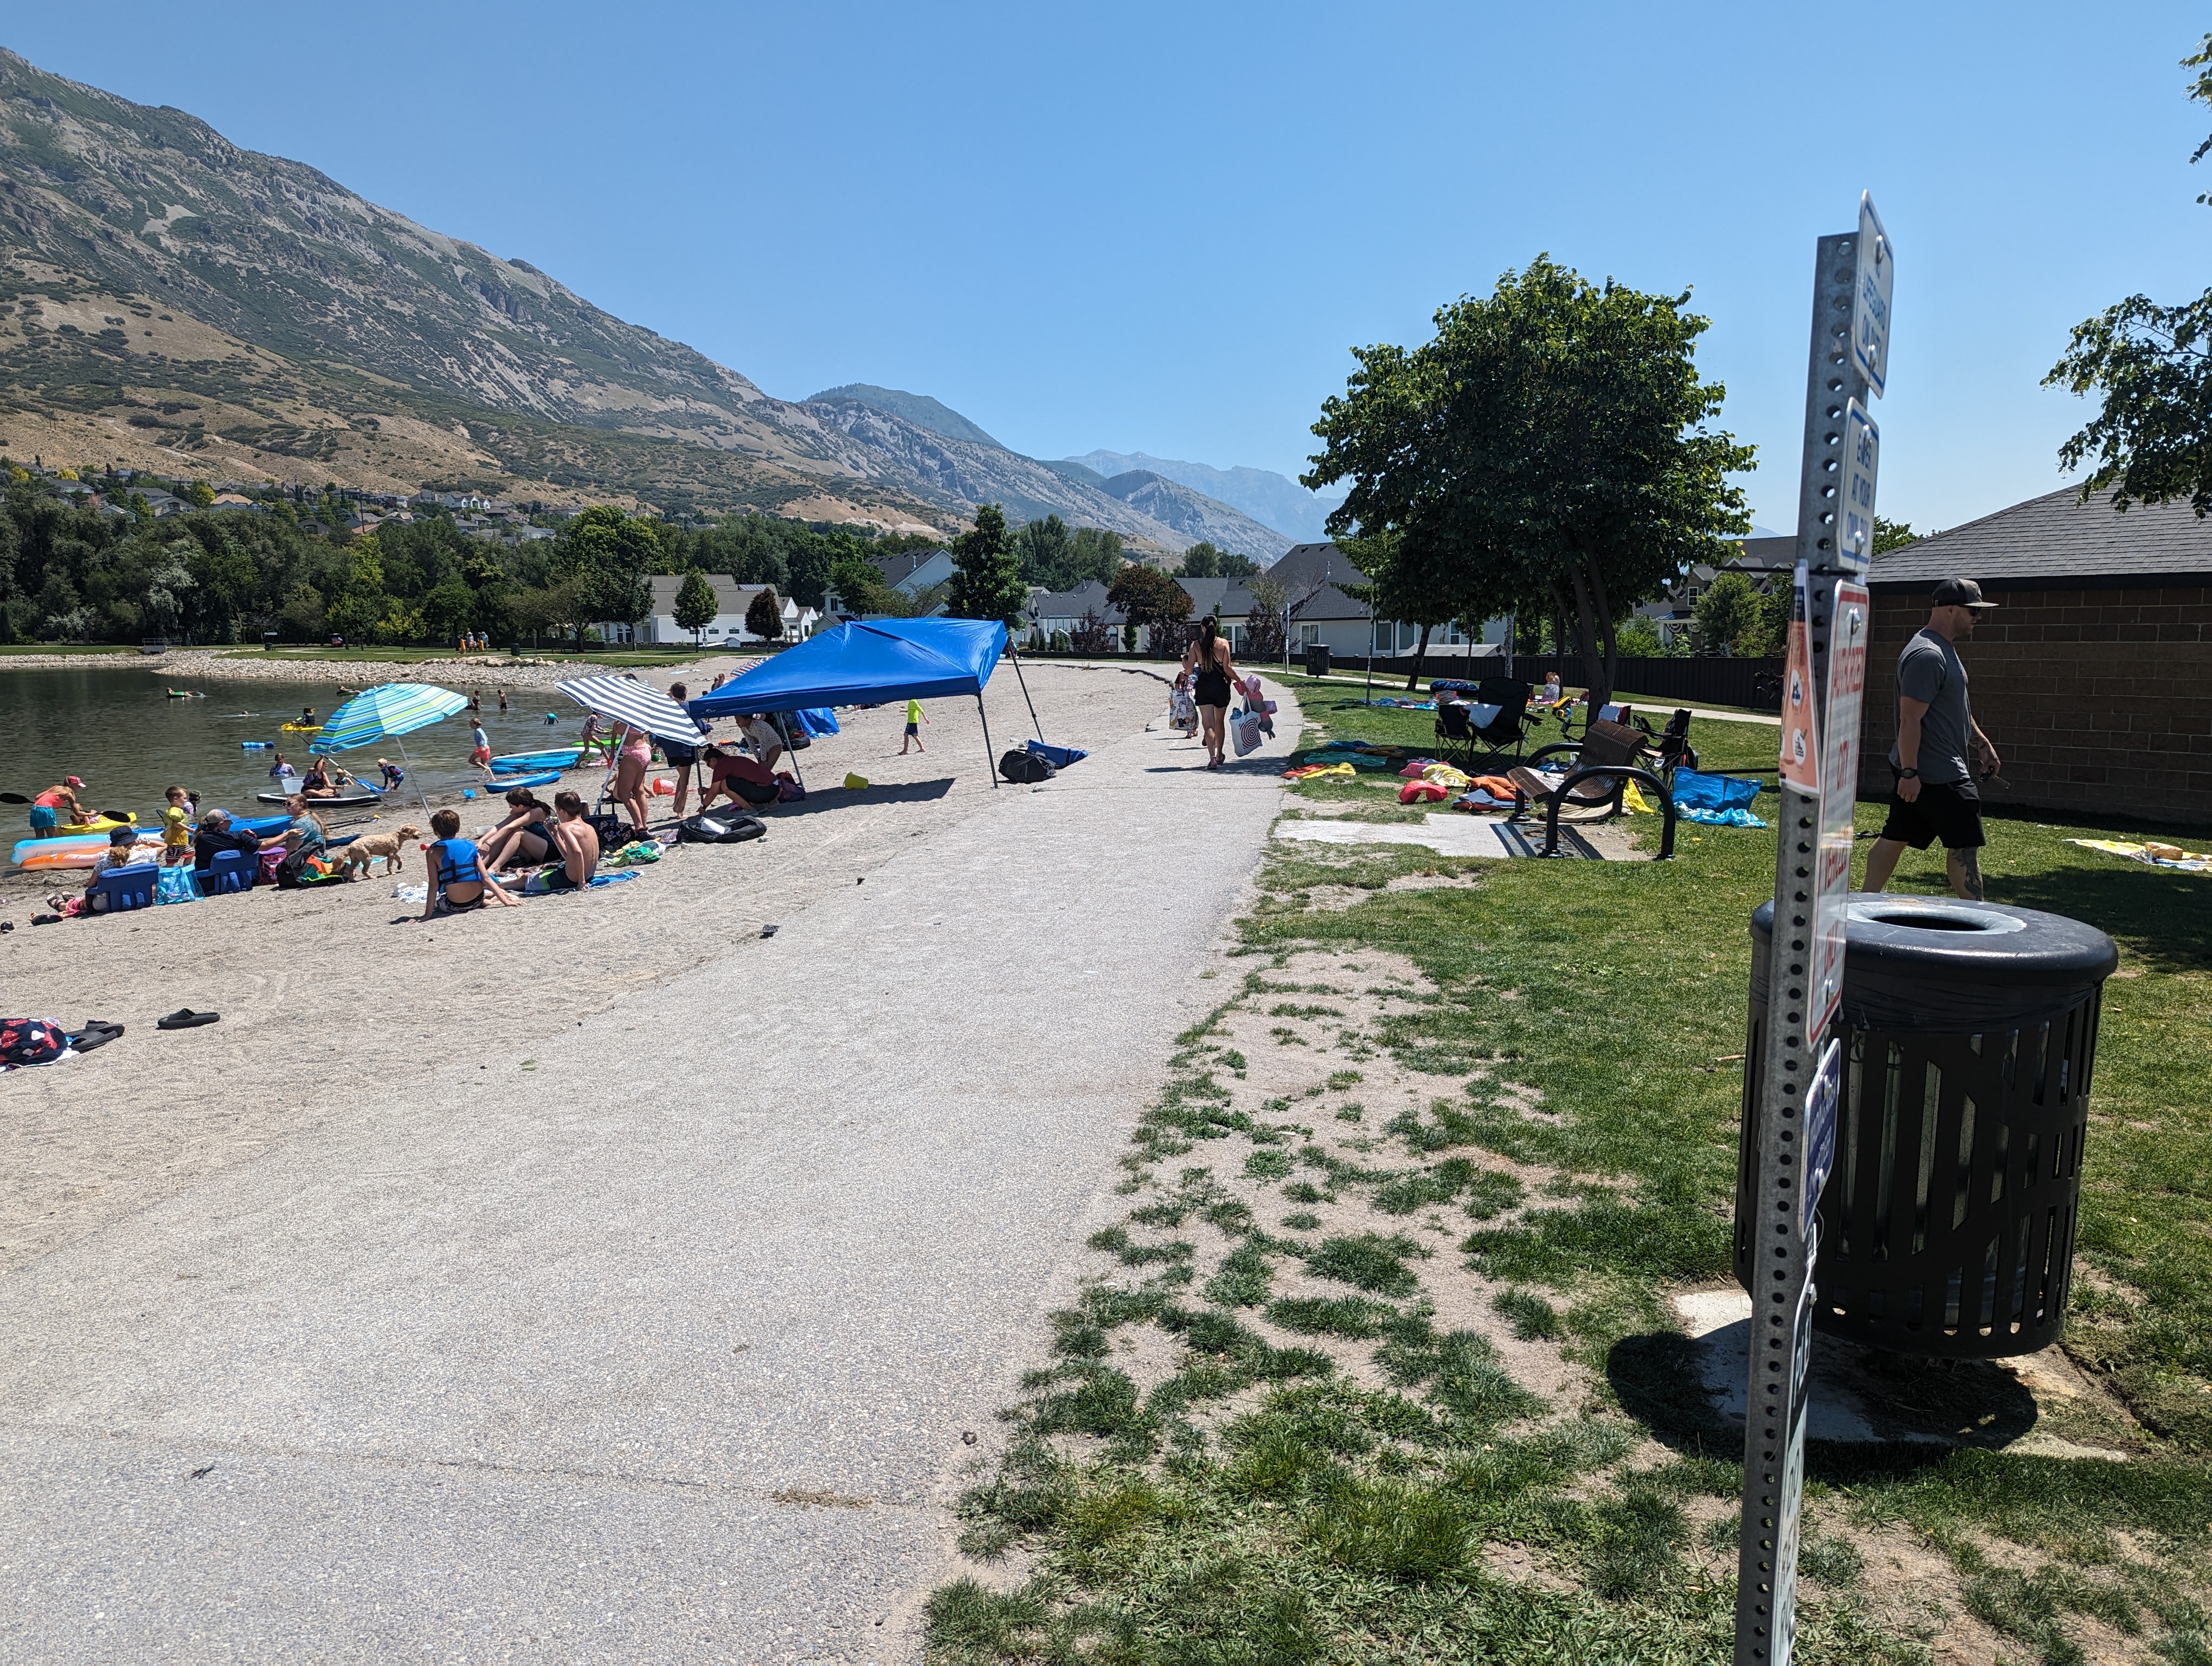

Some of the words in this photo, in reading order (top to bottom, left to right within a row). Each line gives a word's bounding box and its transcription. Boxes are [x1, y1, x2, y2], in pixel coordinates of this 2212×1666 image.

[1851, 472, 1859, 502] AT
[1859, 475, 1870, 509] YOUR
[1832, 646, 1865, 699] AUTHORIZED
[1837, 739, 1850, 791] CITY
[1824, 919, 1839, 977] ONLY
[1793, 1312, 1812, 1408] PLE
[1787, 1447, 1800, 1519] DO
